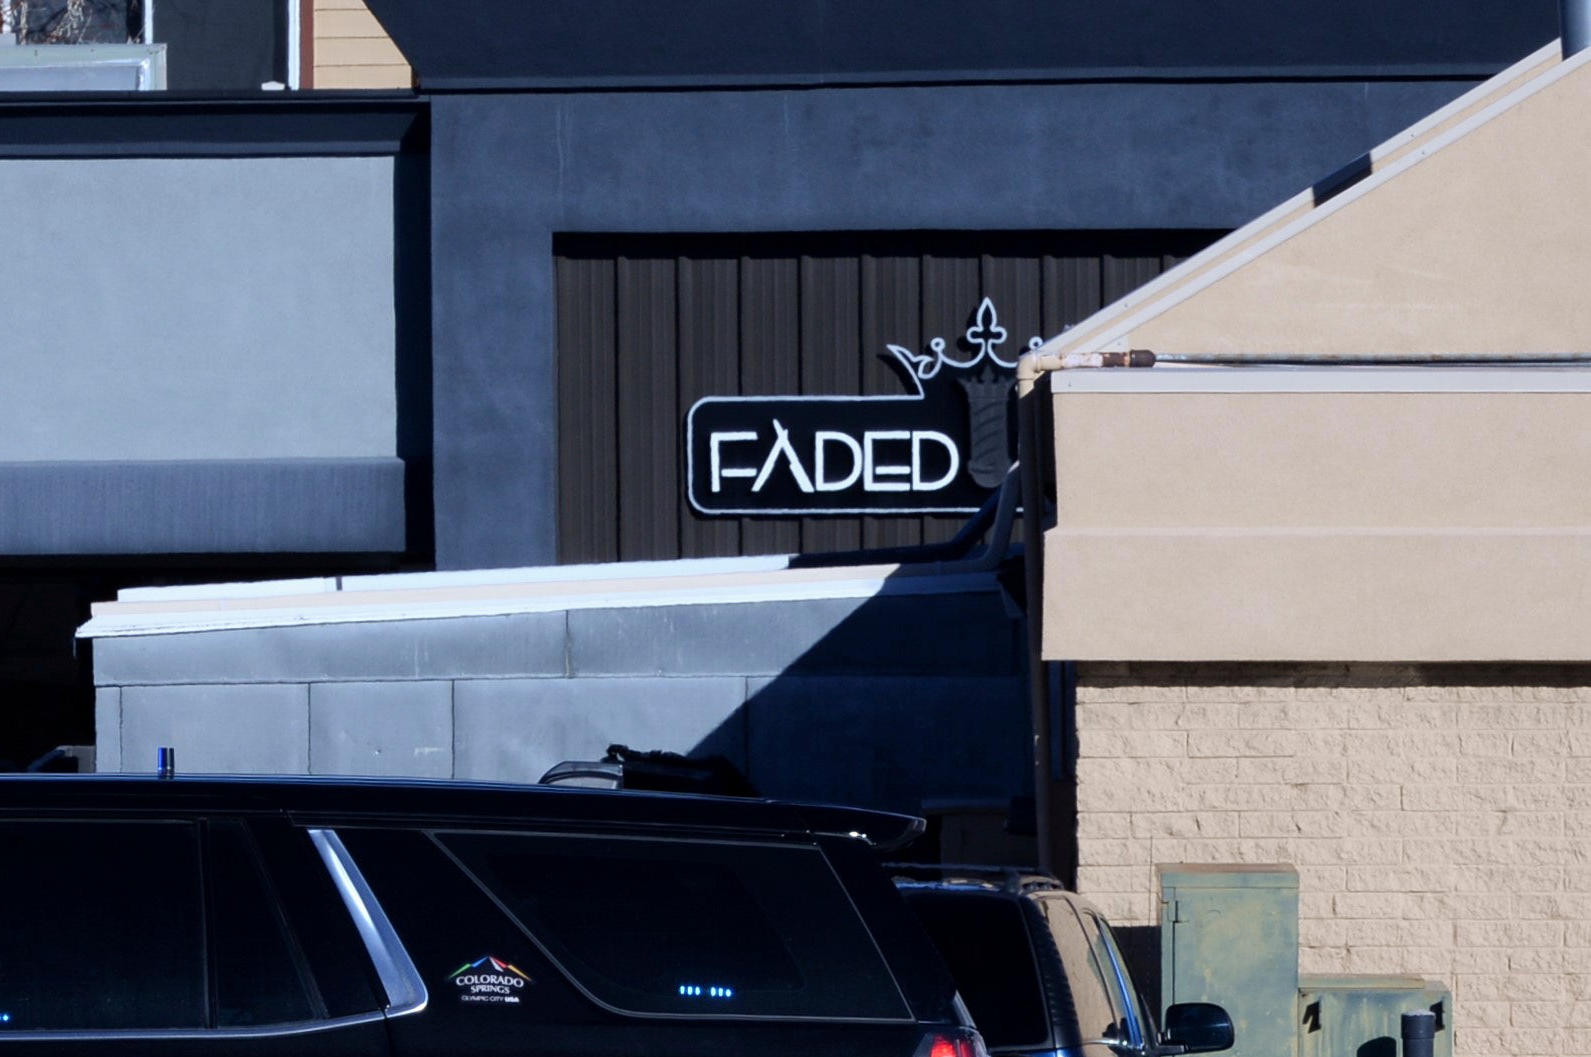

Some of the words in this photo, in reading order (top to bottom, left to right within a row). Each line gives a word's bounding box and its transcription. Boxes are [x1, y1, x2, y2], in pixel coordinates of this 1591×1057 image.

[710, 418, 960, 494] FADED
[456, 975, 524, 987] COLORADO
[470, 985, 510, 994] SPRINGS
[489, 995, 504, 1003] CITY
